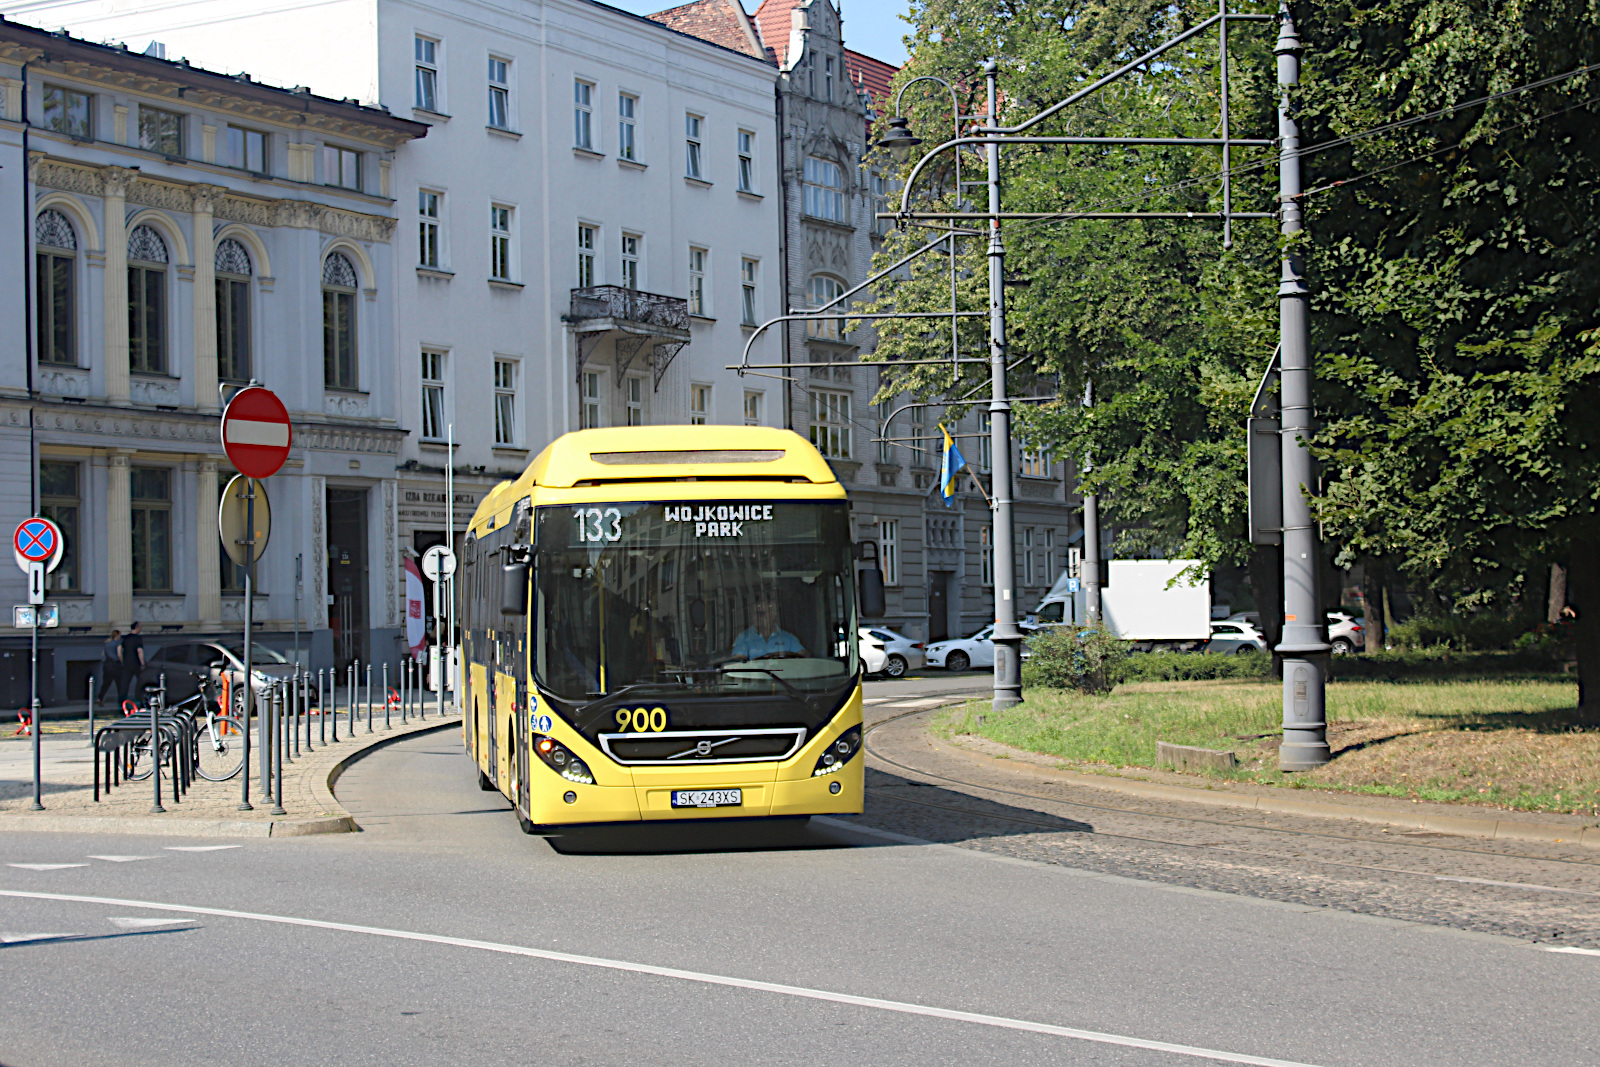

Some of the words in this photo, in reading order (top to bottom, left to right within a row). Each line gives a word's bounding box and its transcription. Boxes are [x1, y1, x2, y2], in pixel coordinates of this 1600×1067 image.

[405, 491, 420, 501] IZBA
[664, 505, 773, 522] WOJKOWICE
[573, 508, 622, 542] 133
[695, 521, 743, 538] PARK
[1069, 580, 1077, 591] P
[615, 707, 667, 733] 900
[680, 792, 695, 805] SK
[700, 791, 738, 804] 243XS
